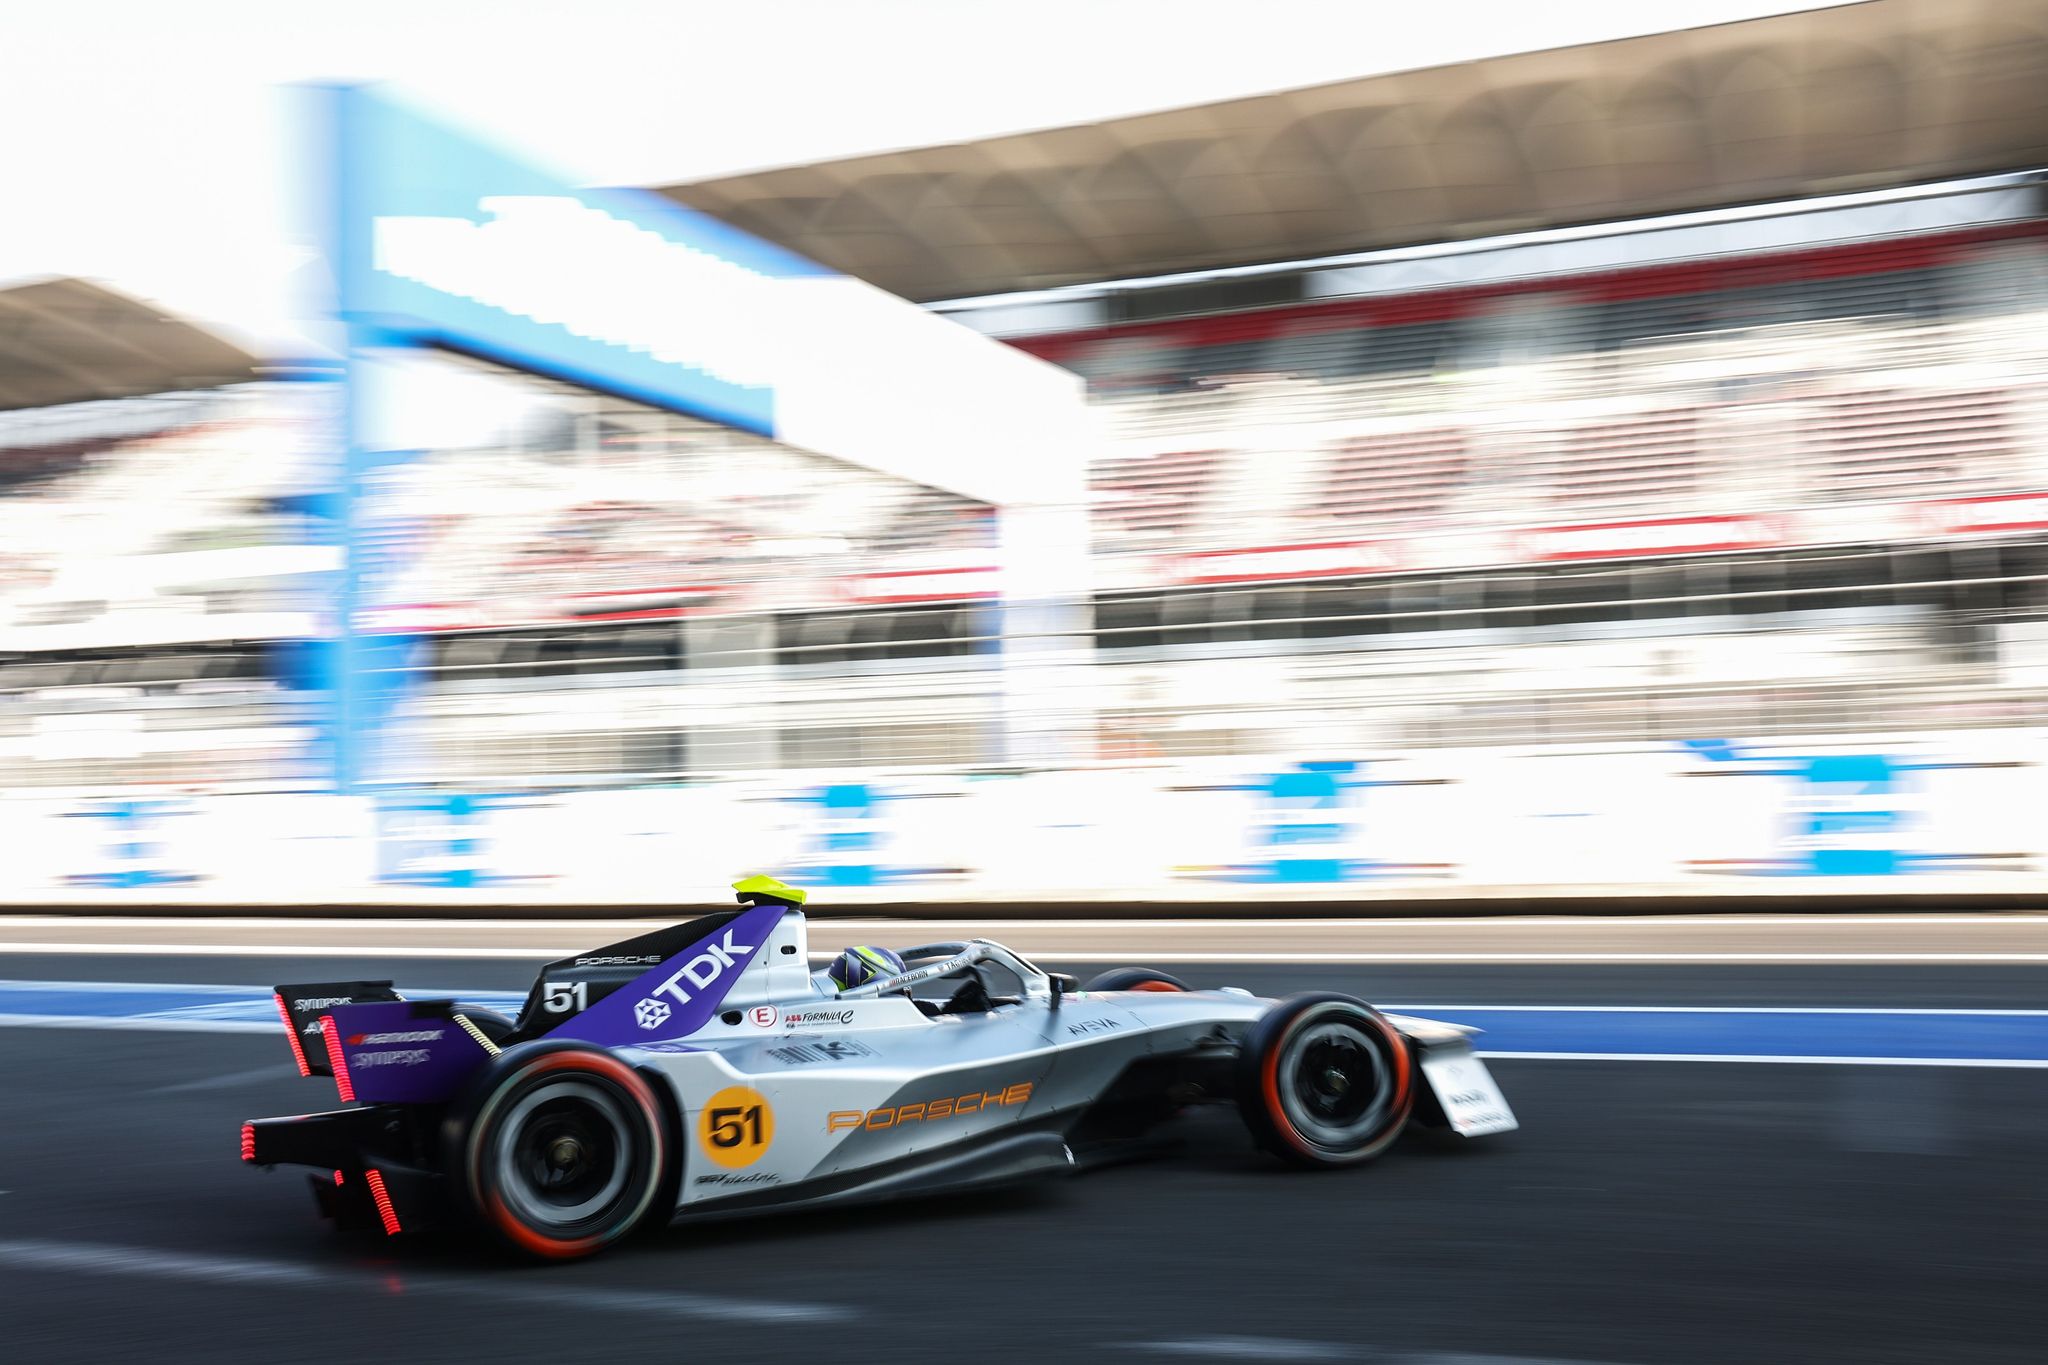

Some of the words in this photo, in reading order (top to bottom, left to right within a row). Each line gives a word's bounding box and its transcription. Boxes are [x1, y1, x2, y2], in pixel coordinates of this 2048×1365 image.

[575, 955, 661, 967] PORSCHE
[651, 928, 754, 1006] TDK
[543, 981, 588, 1014] 51
[802, 1011, 841, 1022] FORMULA
[1067, 1018, 1121, 1036] AVEVA
[827, 1082, 1034, 1135] PORSCHE
[709, 1105, 764, 1148] 51
